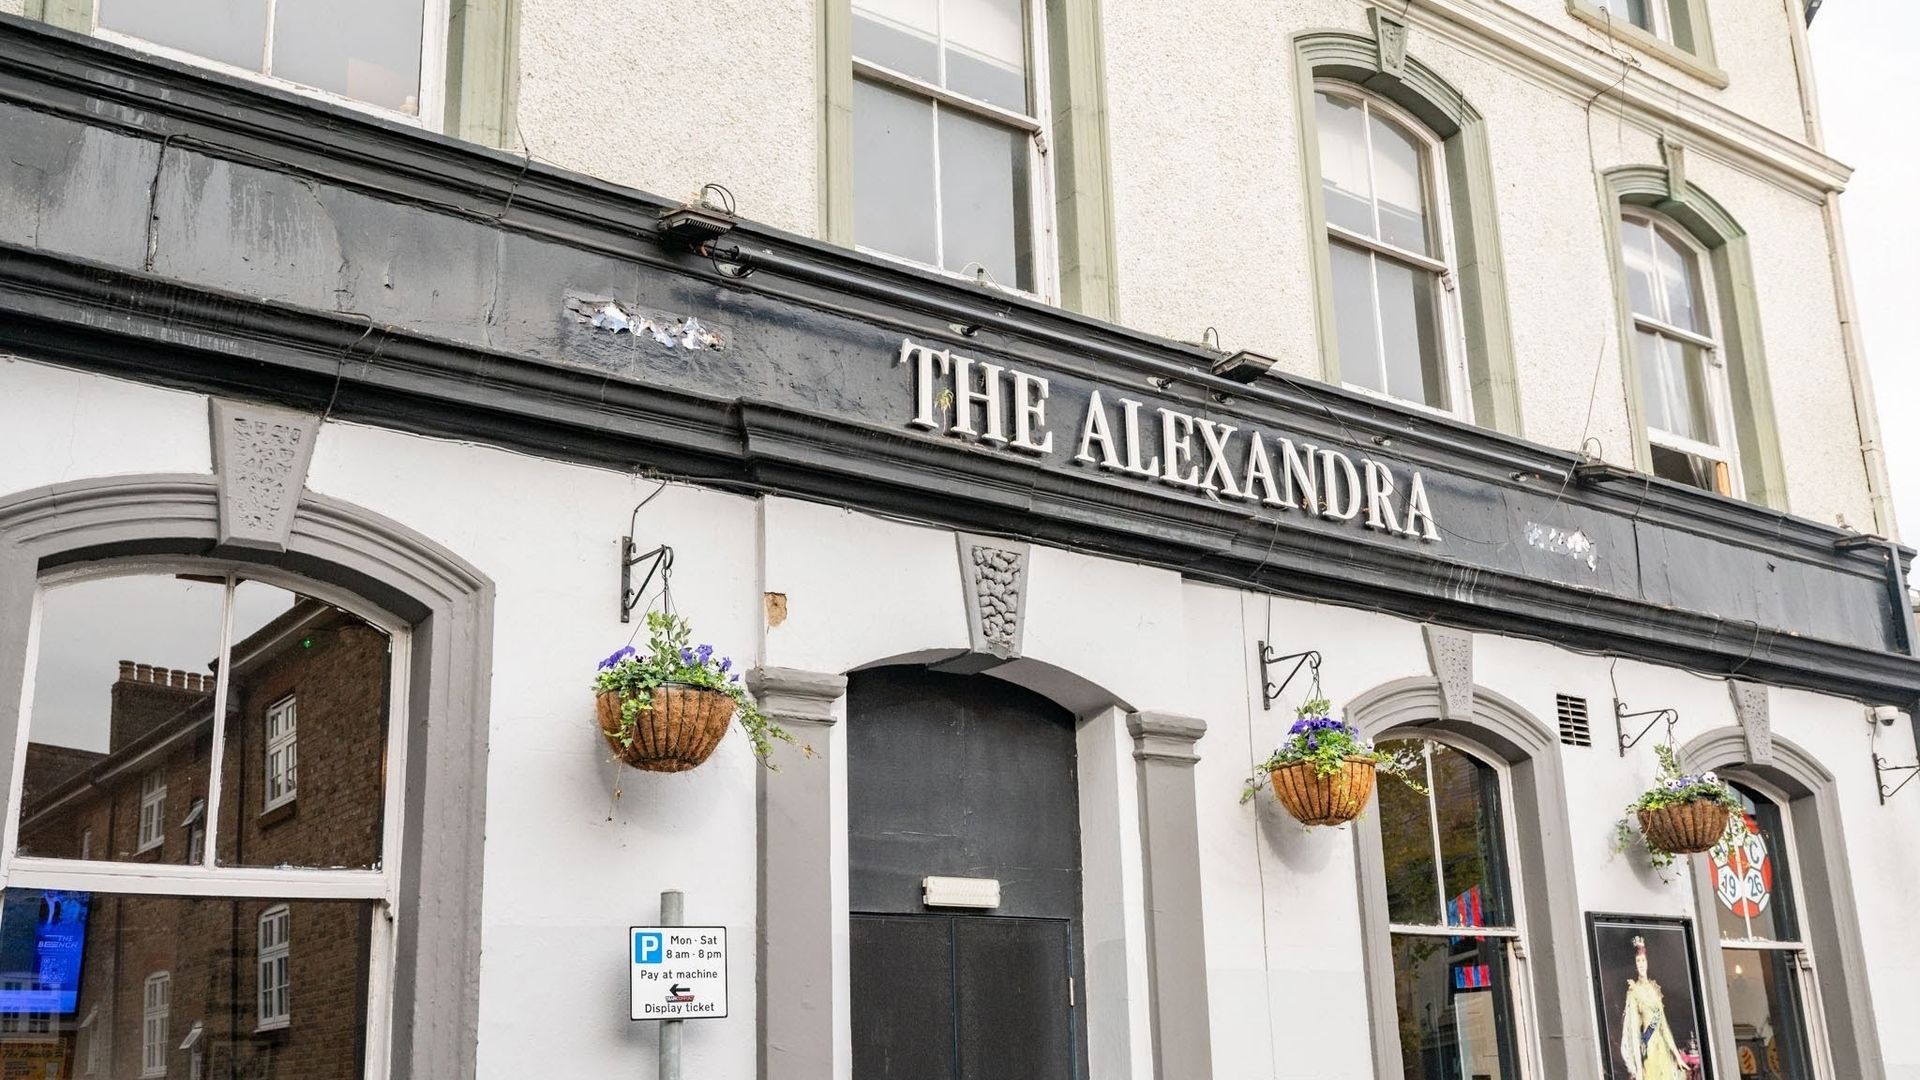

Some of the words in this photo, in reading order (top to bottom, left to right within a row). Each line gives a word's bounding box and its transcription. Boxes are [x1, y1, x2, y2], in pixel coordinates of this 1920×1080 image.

[900, 338, 1053, 453] THE
[1075, 390, 1442, 541] ALEXANDRA
[1722, 874, 1737, 898] 19
[1747, 874, 1764, 897] 26
[641, 936, 658, 960] P
[670, 936, 692, 945] Mon
[700, 936, 717, 945] Sat
[640, 970, 659, 981] Pay
[662, 970, 673, 979] at
[676, 970, 718, 979] machine
[645, 1003, 682, 1014] Display
[686, 1002, 715, 1012] ticket
